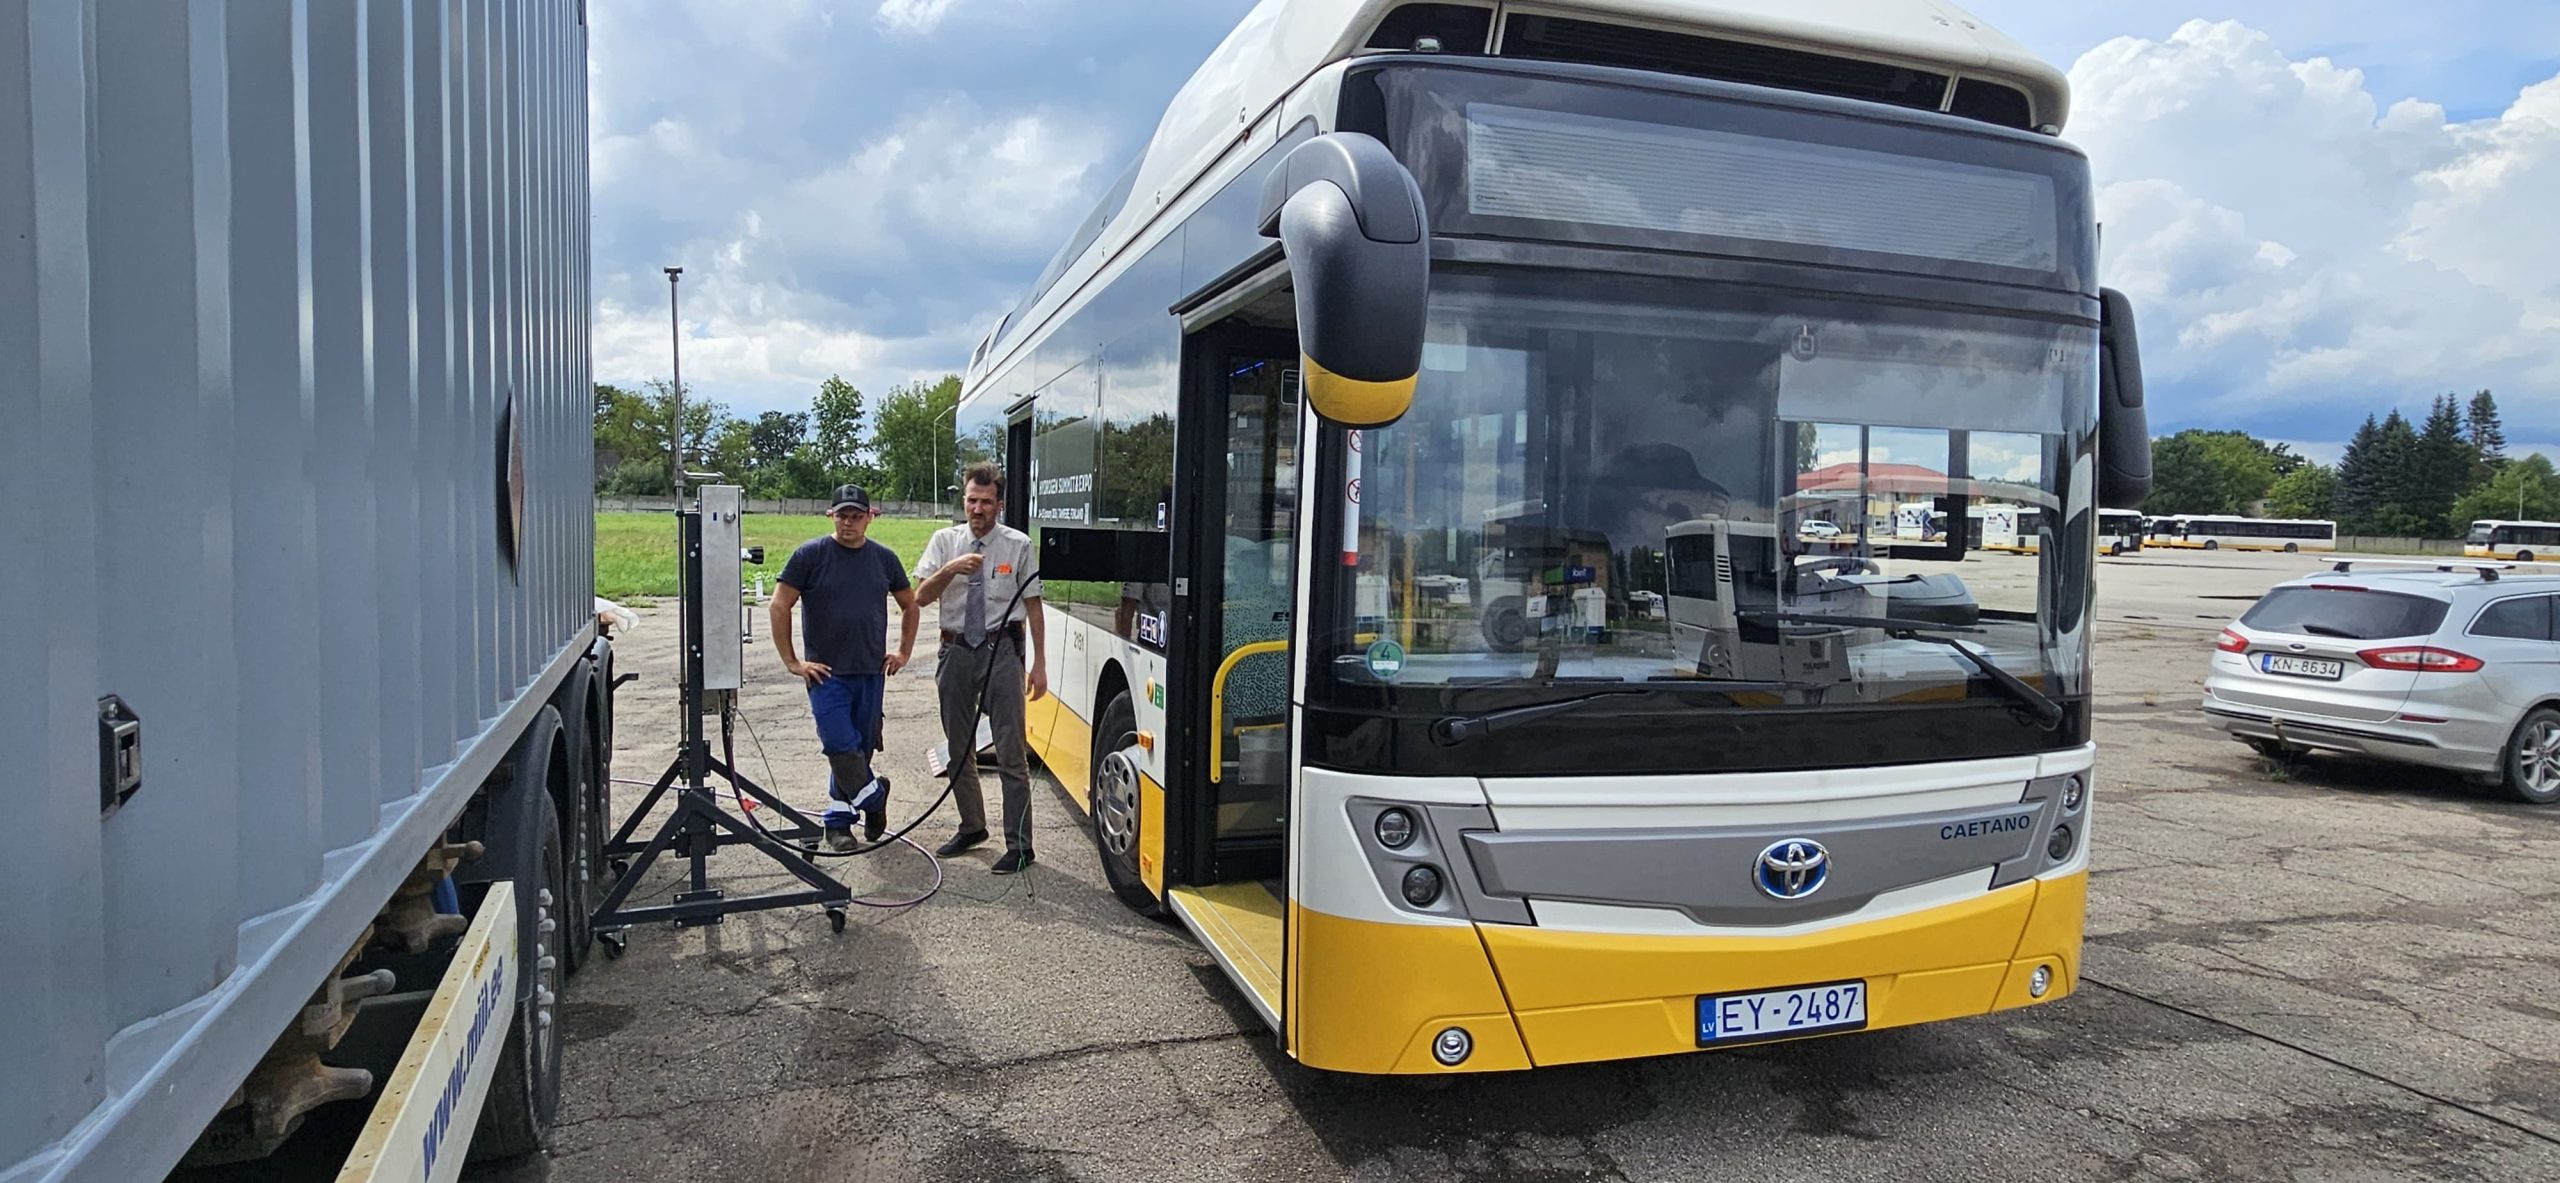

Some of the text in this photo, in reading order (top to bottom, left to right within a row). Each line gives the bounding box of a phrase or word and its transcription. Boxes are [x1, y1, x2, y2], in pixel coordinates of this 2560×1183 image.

[1079, 472, 1092, 492] EXPO
[1381, 644, 1391, 660] 4
[2272, 657, 2337, 676] KN-8634
[1940, 815, 2031, 840] CAETANO
[1722, 986, 1858, 1033] EY-2487
[1702, 1022, 1715, 1033] LV
[422, 954, 503, 1183] www.miil.ee
